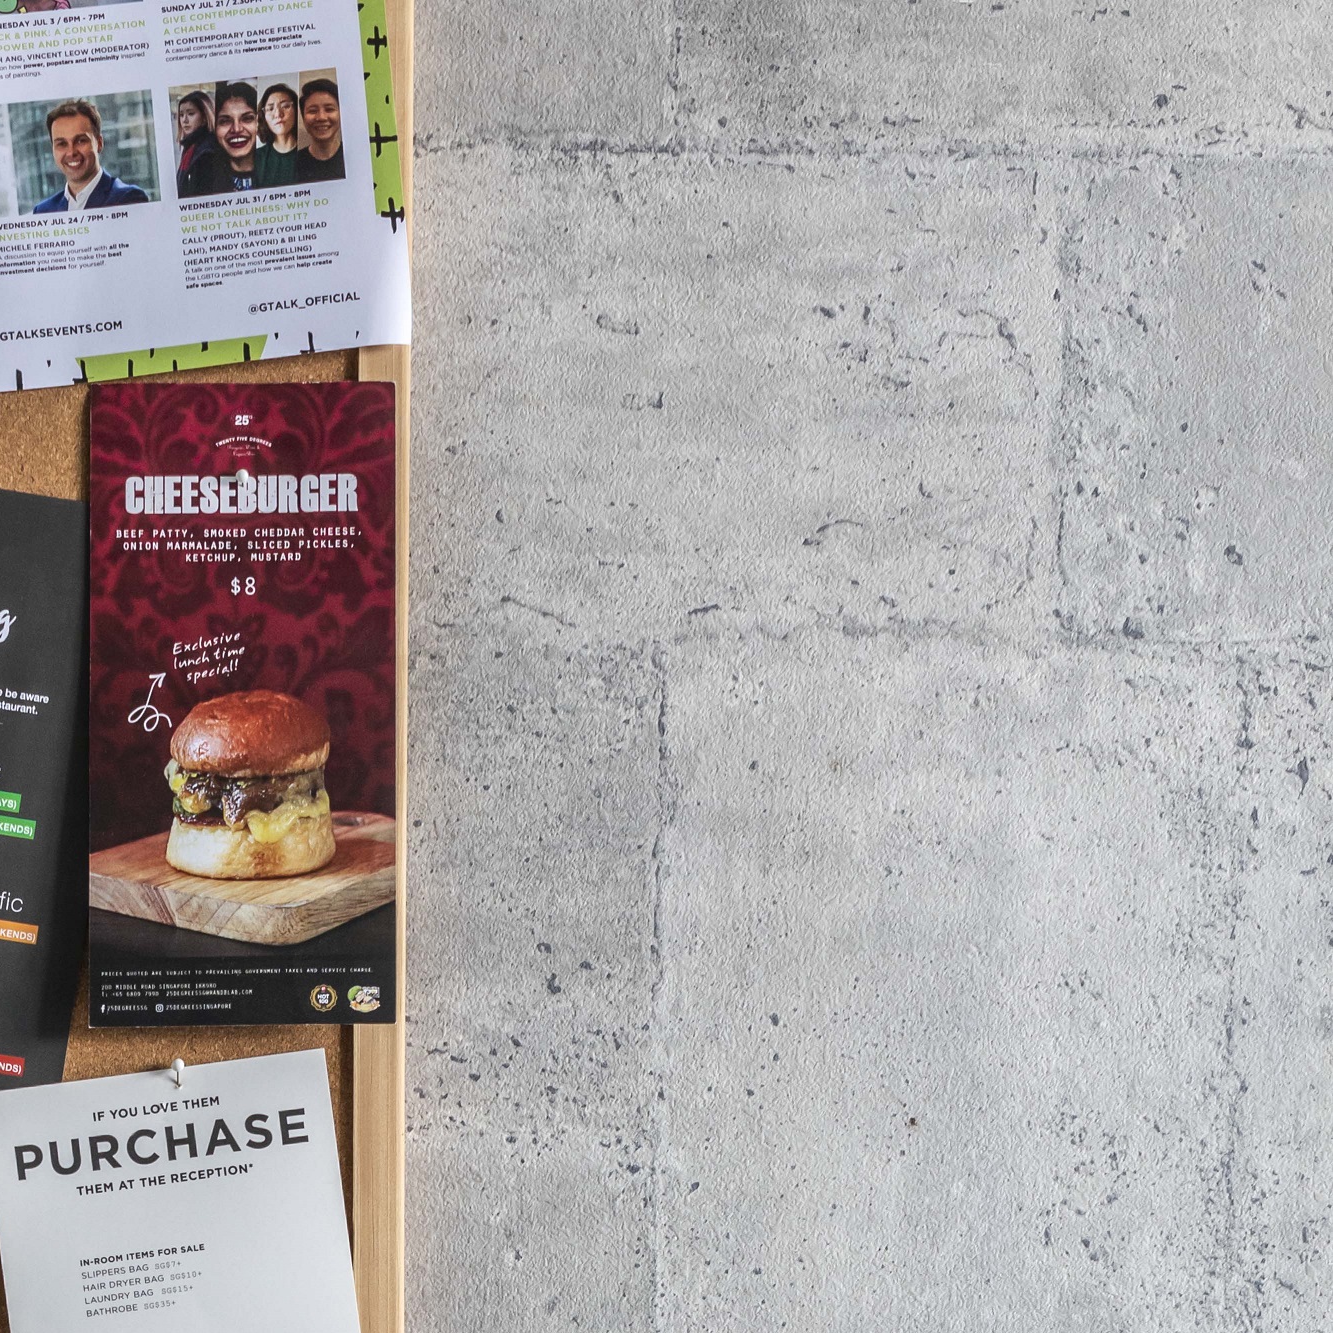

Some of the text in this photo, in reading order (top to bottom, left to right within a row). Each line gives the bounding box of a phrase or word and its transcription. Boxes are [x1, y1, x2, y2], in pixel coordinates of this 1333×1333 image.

[53, 226, 90, 237] BASICS
[33, 239, 76, 250] FERRARIO
[248, 291, 361, 313] @GTALK_OFFICIAL
[0, 320, 123, 342] GTALKSEVENTS.COM
[125, 472, 359, 515] CHEESEBURGER
[116, 526, 362, 539] BEEF PATTY, SMOKED CHEDDAR CHEESE,
[172, 632, 241, 655] Exclusive
[173, 646, 245, 670] lunch time
[186, 659, 239, 685] special!
[92, 1095, 220, 1122] IF YOU LOVE THEM
[14, 1107, 309, 1181] PURCHASE
[76, 1182, 114, 1196] THEM
[118, 1179, 135, 1191] AT
[138, 1174, 166, 1188] THE
[79, 1243, 205, 1267] IN-ROOM ITEMS FOR SALE
